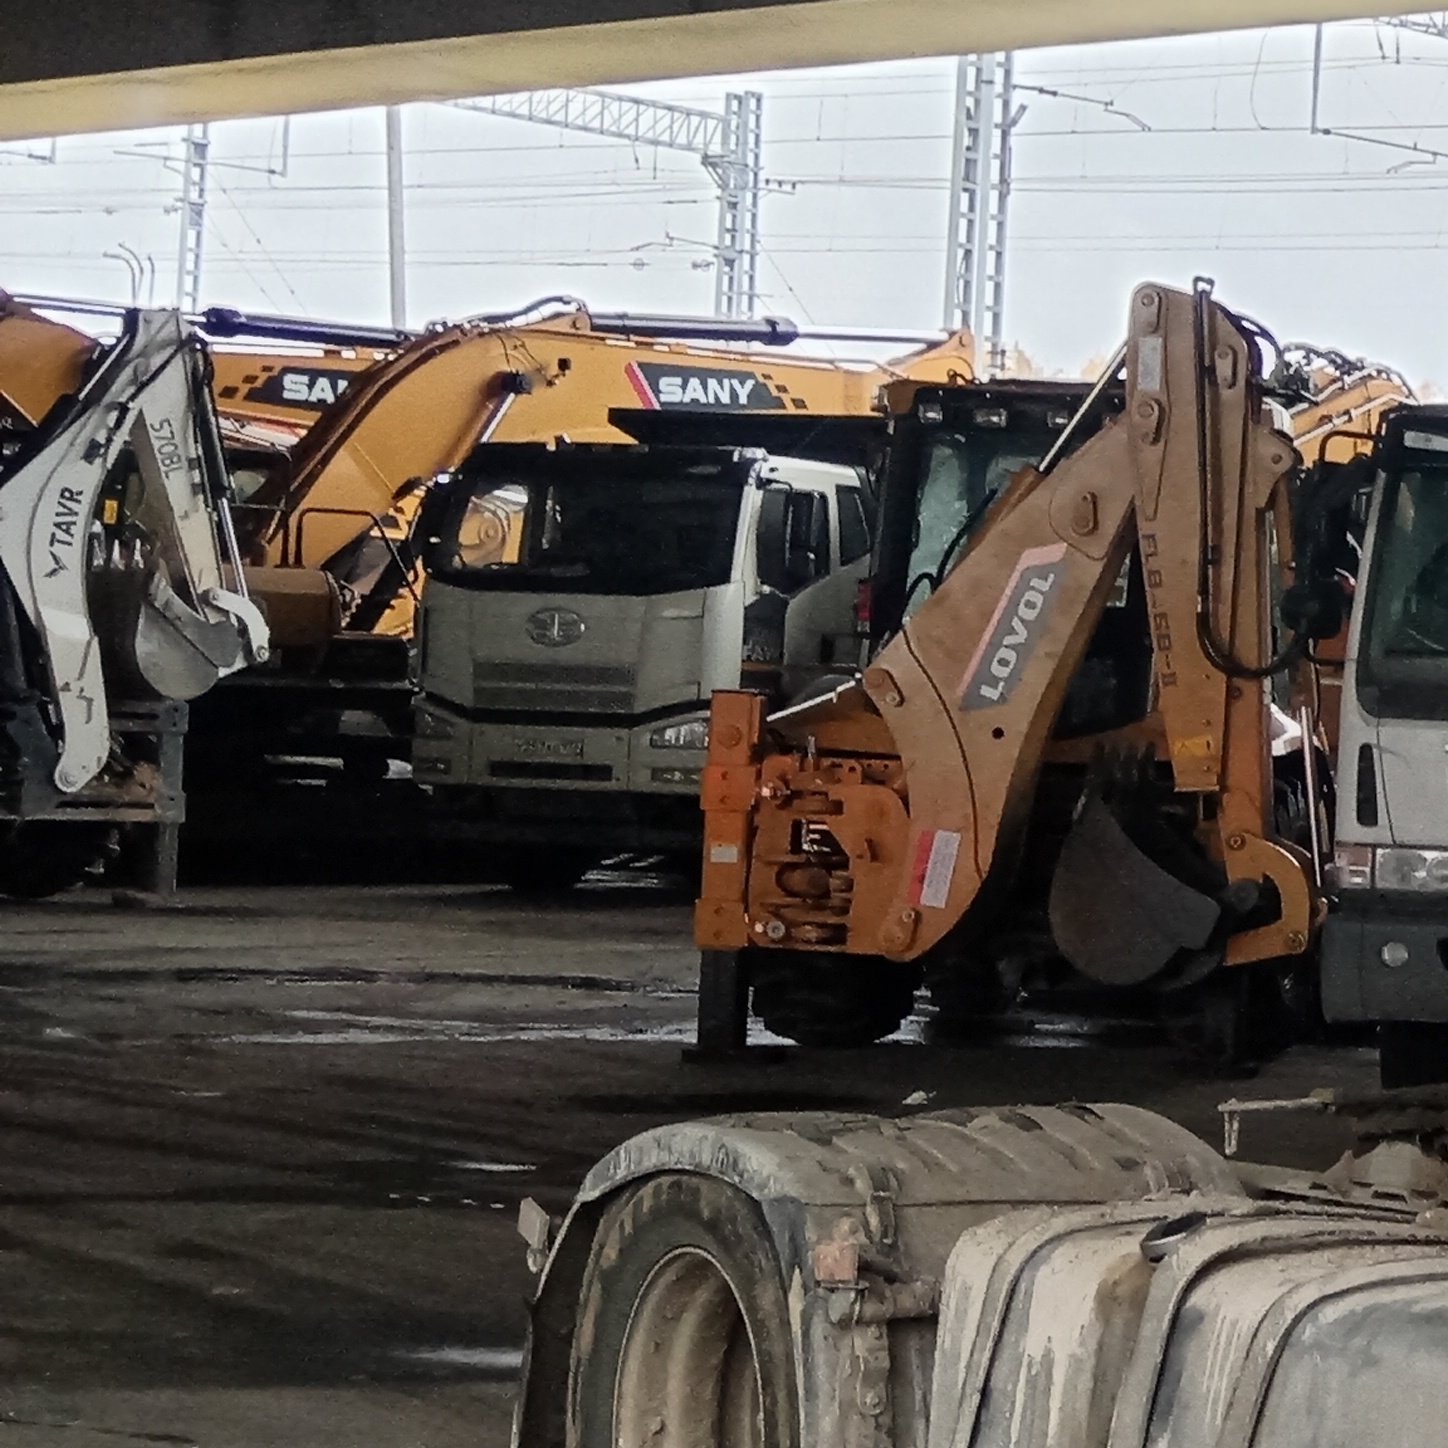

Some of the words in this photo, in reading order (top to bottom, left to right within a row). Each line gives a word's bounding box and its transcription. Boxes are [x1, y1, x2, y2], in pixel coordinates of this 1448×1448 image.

[282, 373, 348, 404] SA
[658, 376, 756, 405] SANY
[49, 486, 84, 547] TAVR
[979, 573, 1055, 702] LOVOL
